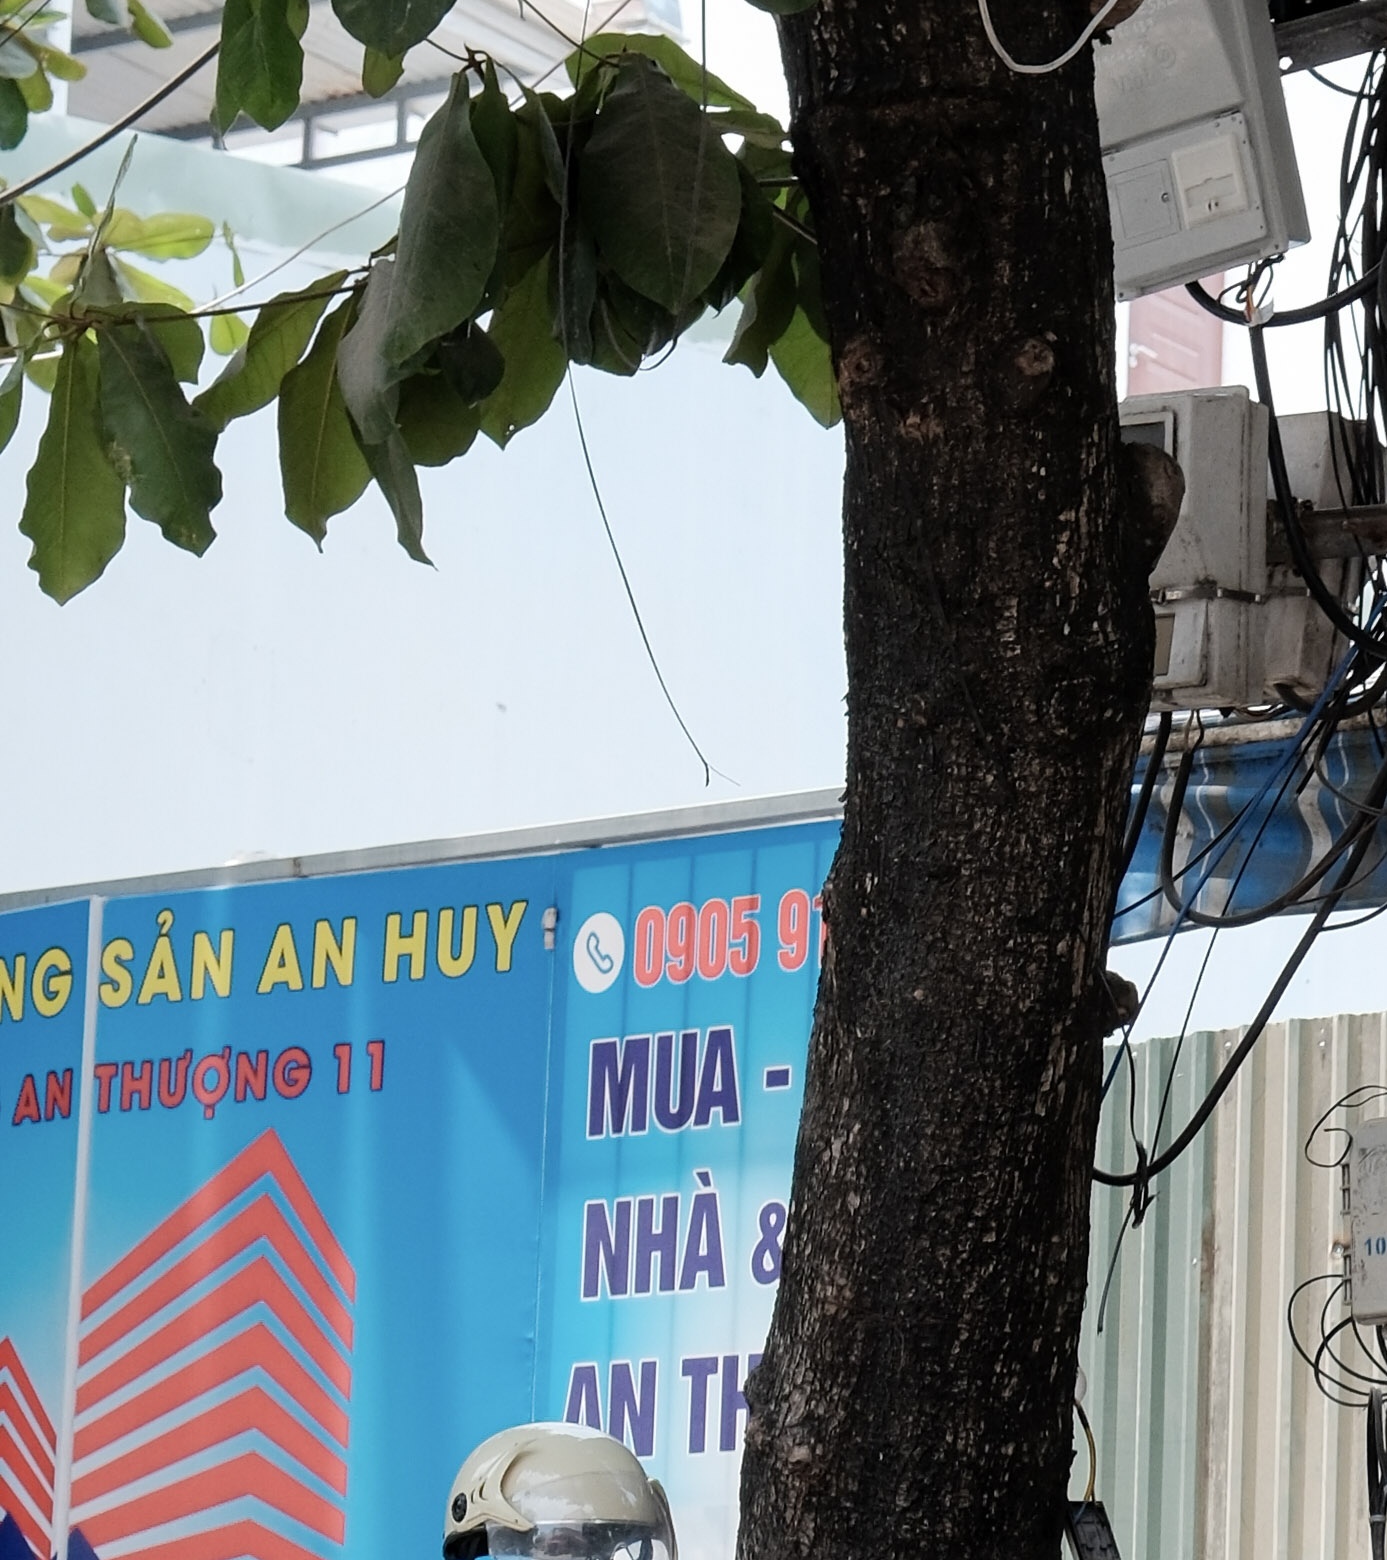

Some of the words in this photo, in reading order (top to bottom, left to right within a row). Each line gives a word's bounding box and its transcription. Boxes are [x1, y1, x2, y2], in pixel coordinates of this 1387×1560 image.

[98, 907, 235, 1009] SẢN
[256, 917, 358, 994] AN
[382, 900, 529, 984] HUY
[633, 895, 761, 988] 0905
[12, 1068, 73, 1126] AN
[94, 1045, 313, 1120] THƯỢNG
[333, 1039, 385, 1094] 11
[586, 1025, 742, 1140] MUA
[580, 1168, 727, 1302] NHÀ
[561, 1359, 658, 1461] AN
